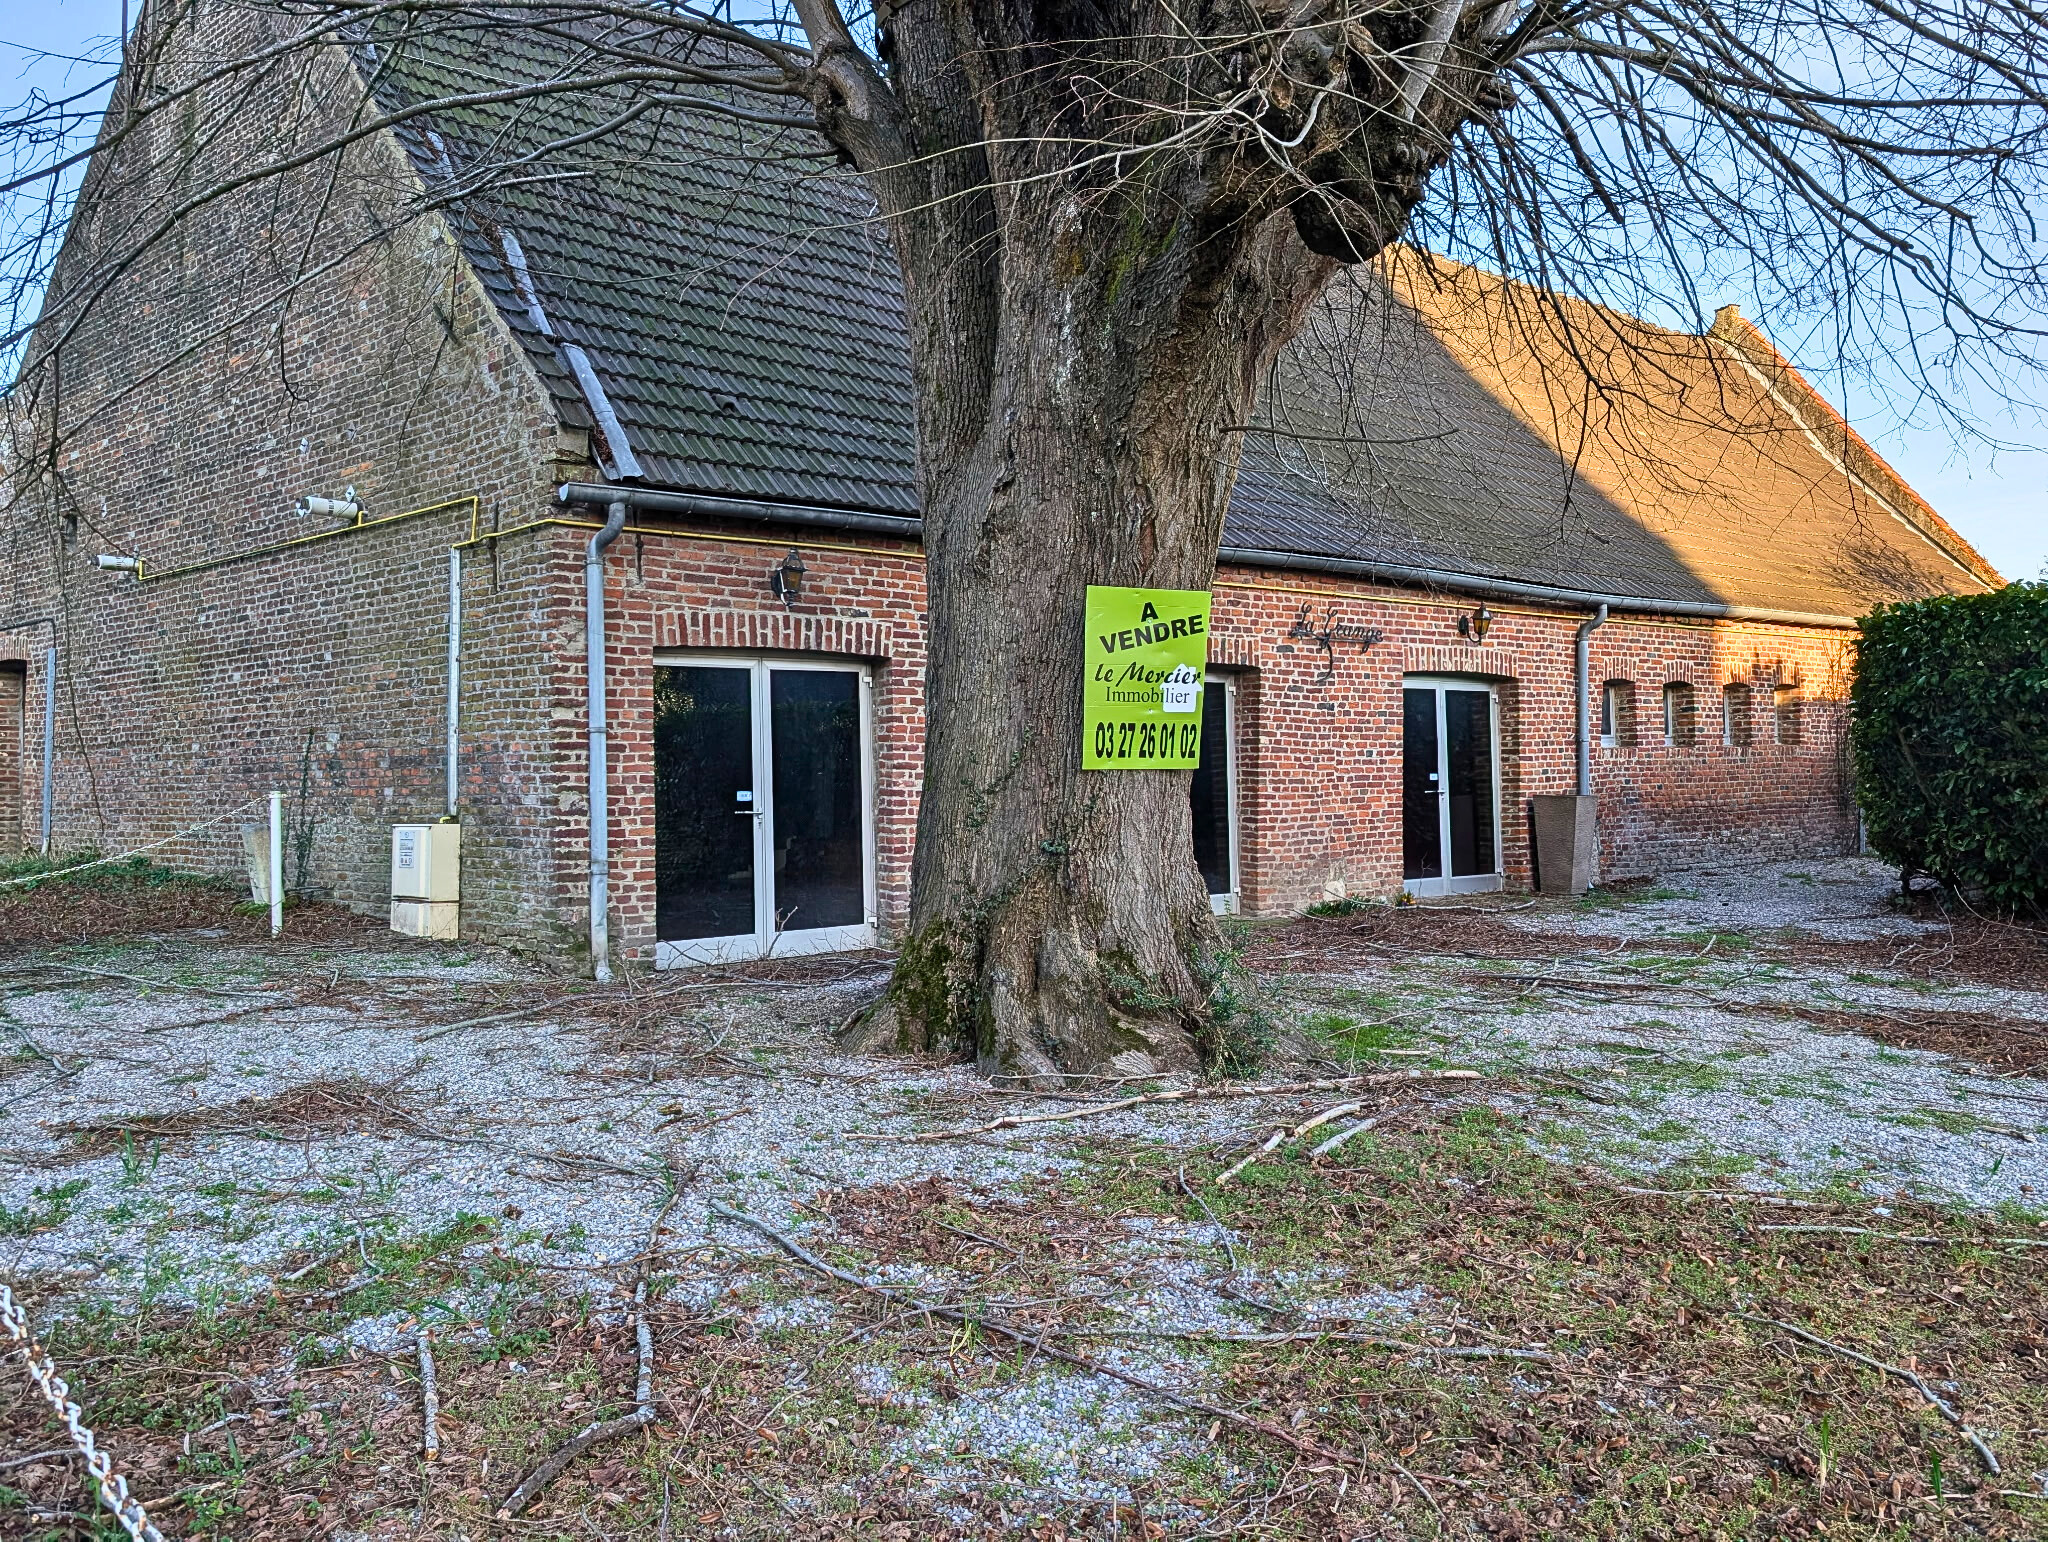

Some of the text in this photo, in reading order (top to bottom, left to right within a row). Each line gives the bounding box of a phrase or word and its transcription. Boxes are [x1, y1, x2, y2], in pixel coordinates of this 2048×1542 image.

[1140, 601, 1159, 622] A
[1099, 613, 1204, 654] VENDRE
[1289, 600, 1383, 682] La Grange
[1115, 661, 1202, 687] Mercier
[1105, 686, 1190, 704] Immobilier
[1095, 721, 1197, 759] 03 27 26 01 02
